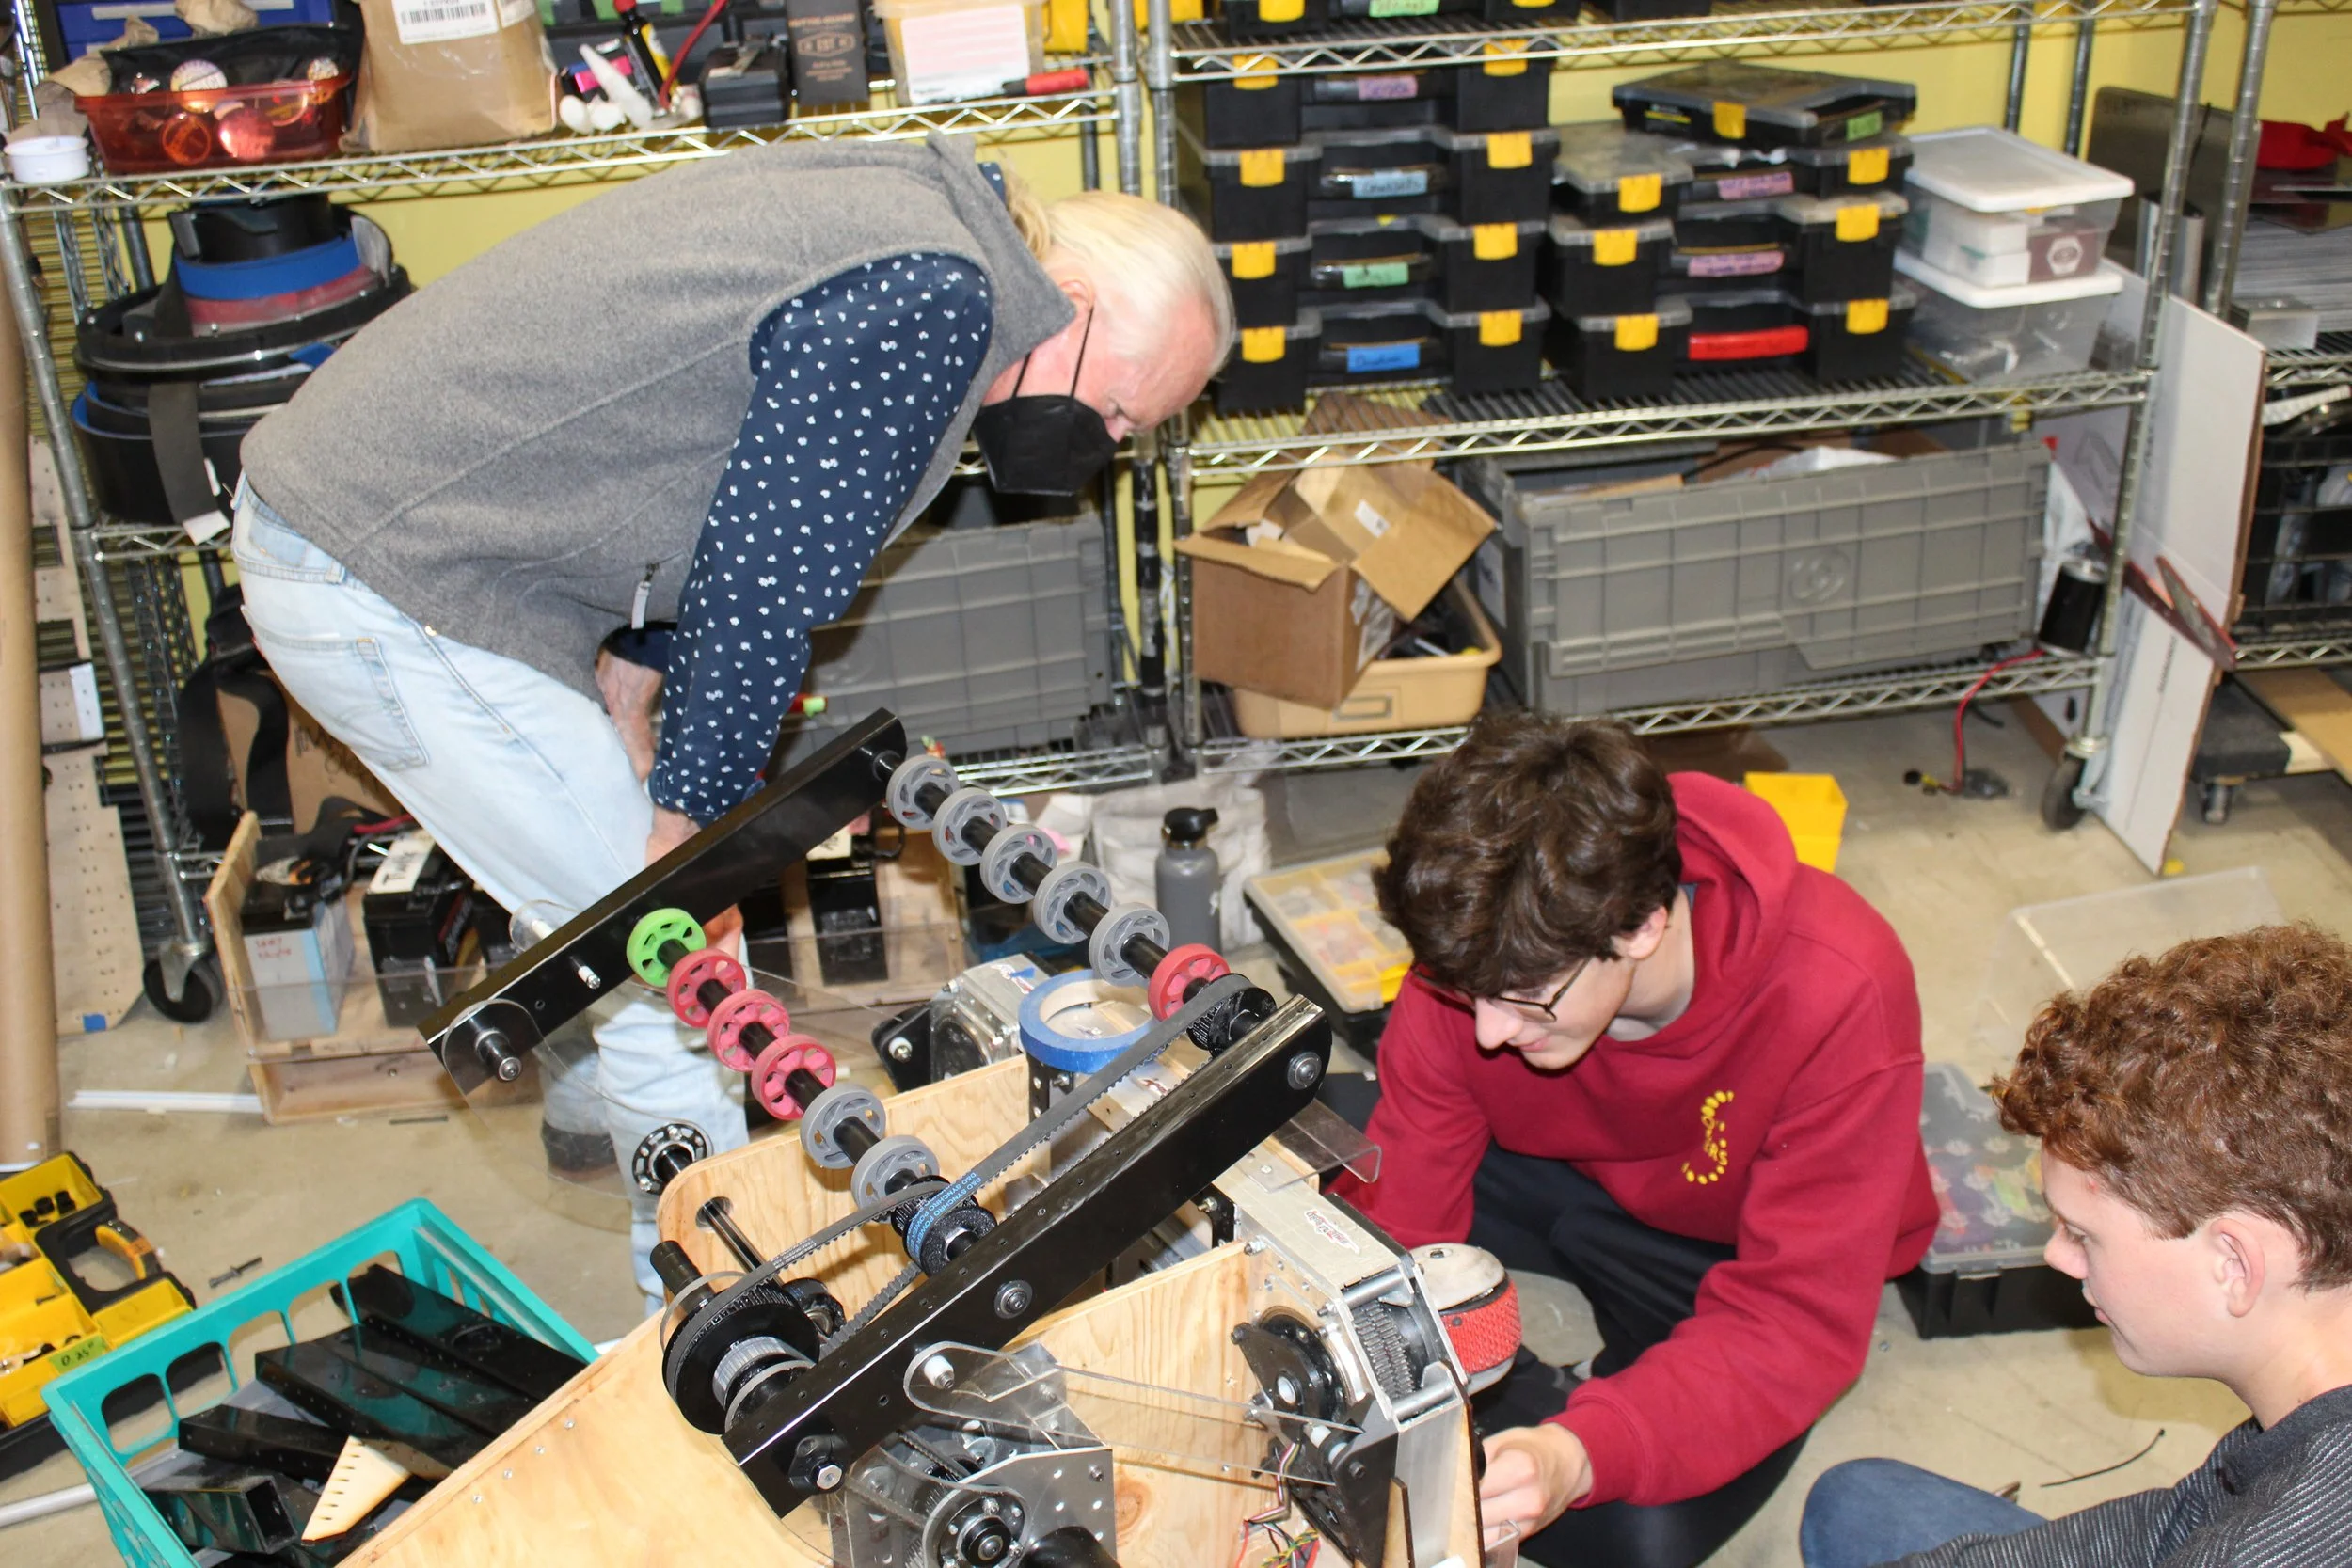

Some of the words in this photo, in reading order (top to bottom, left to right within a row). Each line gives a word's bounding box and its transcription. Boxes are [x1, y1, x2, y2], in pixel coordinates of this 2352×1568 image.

[961, 1172, 977, 1185] D&D
[966, 1177, 982, 1190] D&D
[929, 1183, 961, 1212] SYNCHRO
[933, 1189, 967, 1216] SYNCHRO
[911, 1211, 930, 1240] POWER
[916, 1215, 934, 1244] POWER
